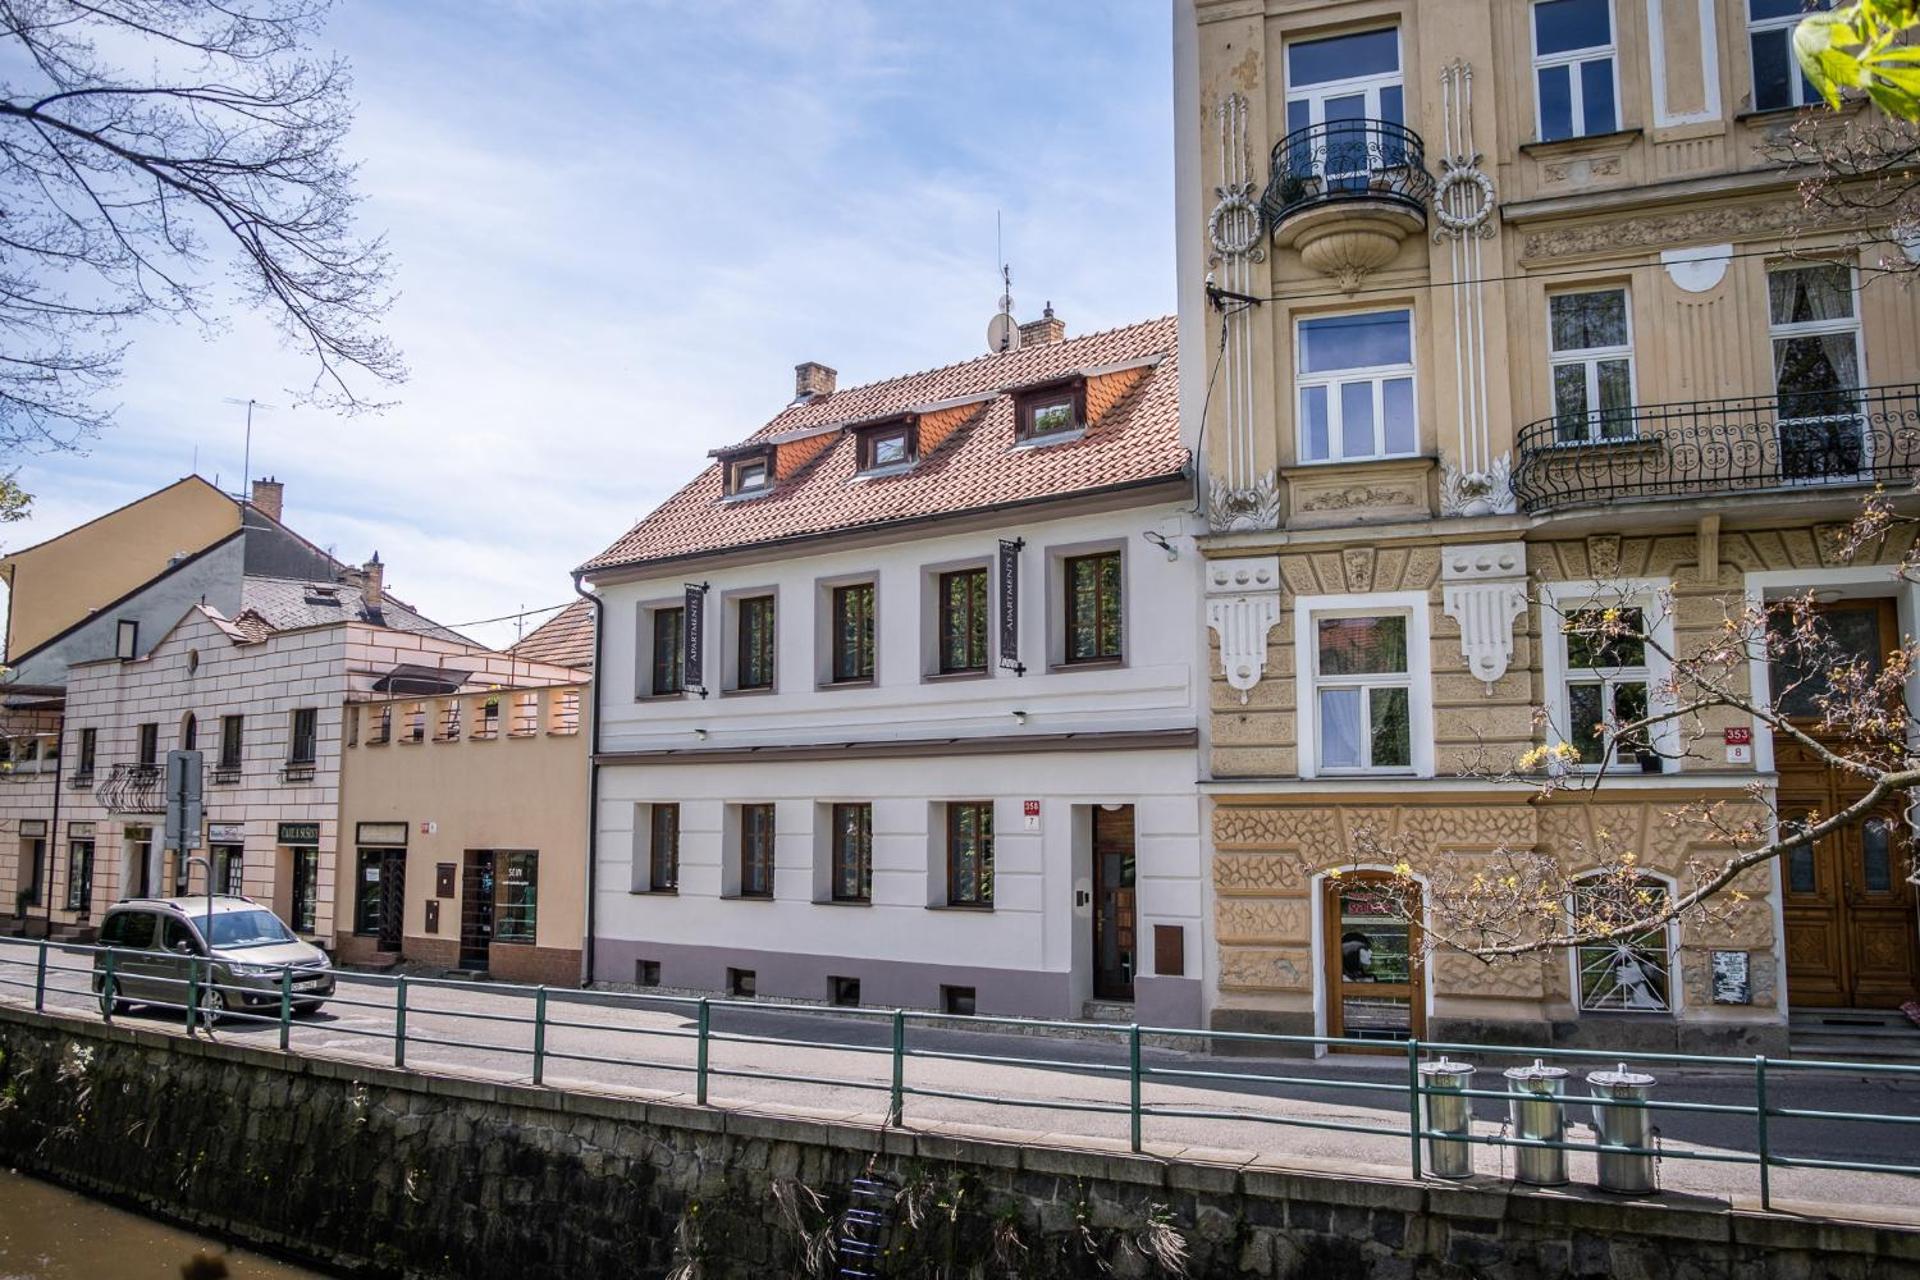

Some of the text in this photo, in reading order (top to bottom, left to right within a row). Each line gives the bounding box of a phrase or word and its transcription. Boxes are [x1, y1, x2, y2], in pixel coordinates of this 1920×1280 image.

[1006, 556, 1014, 632] APARTMENTS
[690, 598, 698, 662] APARTMENTS
[1727, 729, 1748, 739] 353
[1735, 747, 1742, 757] 8
